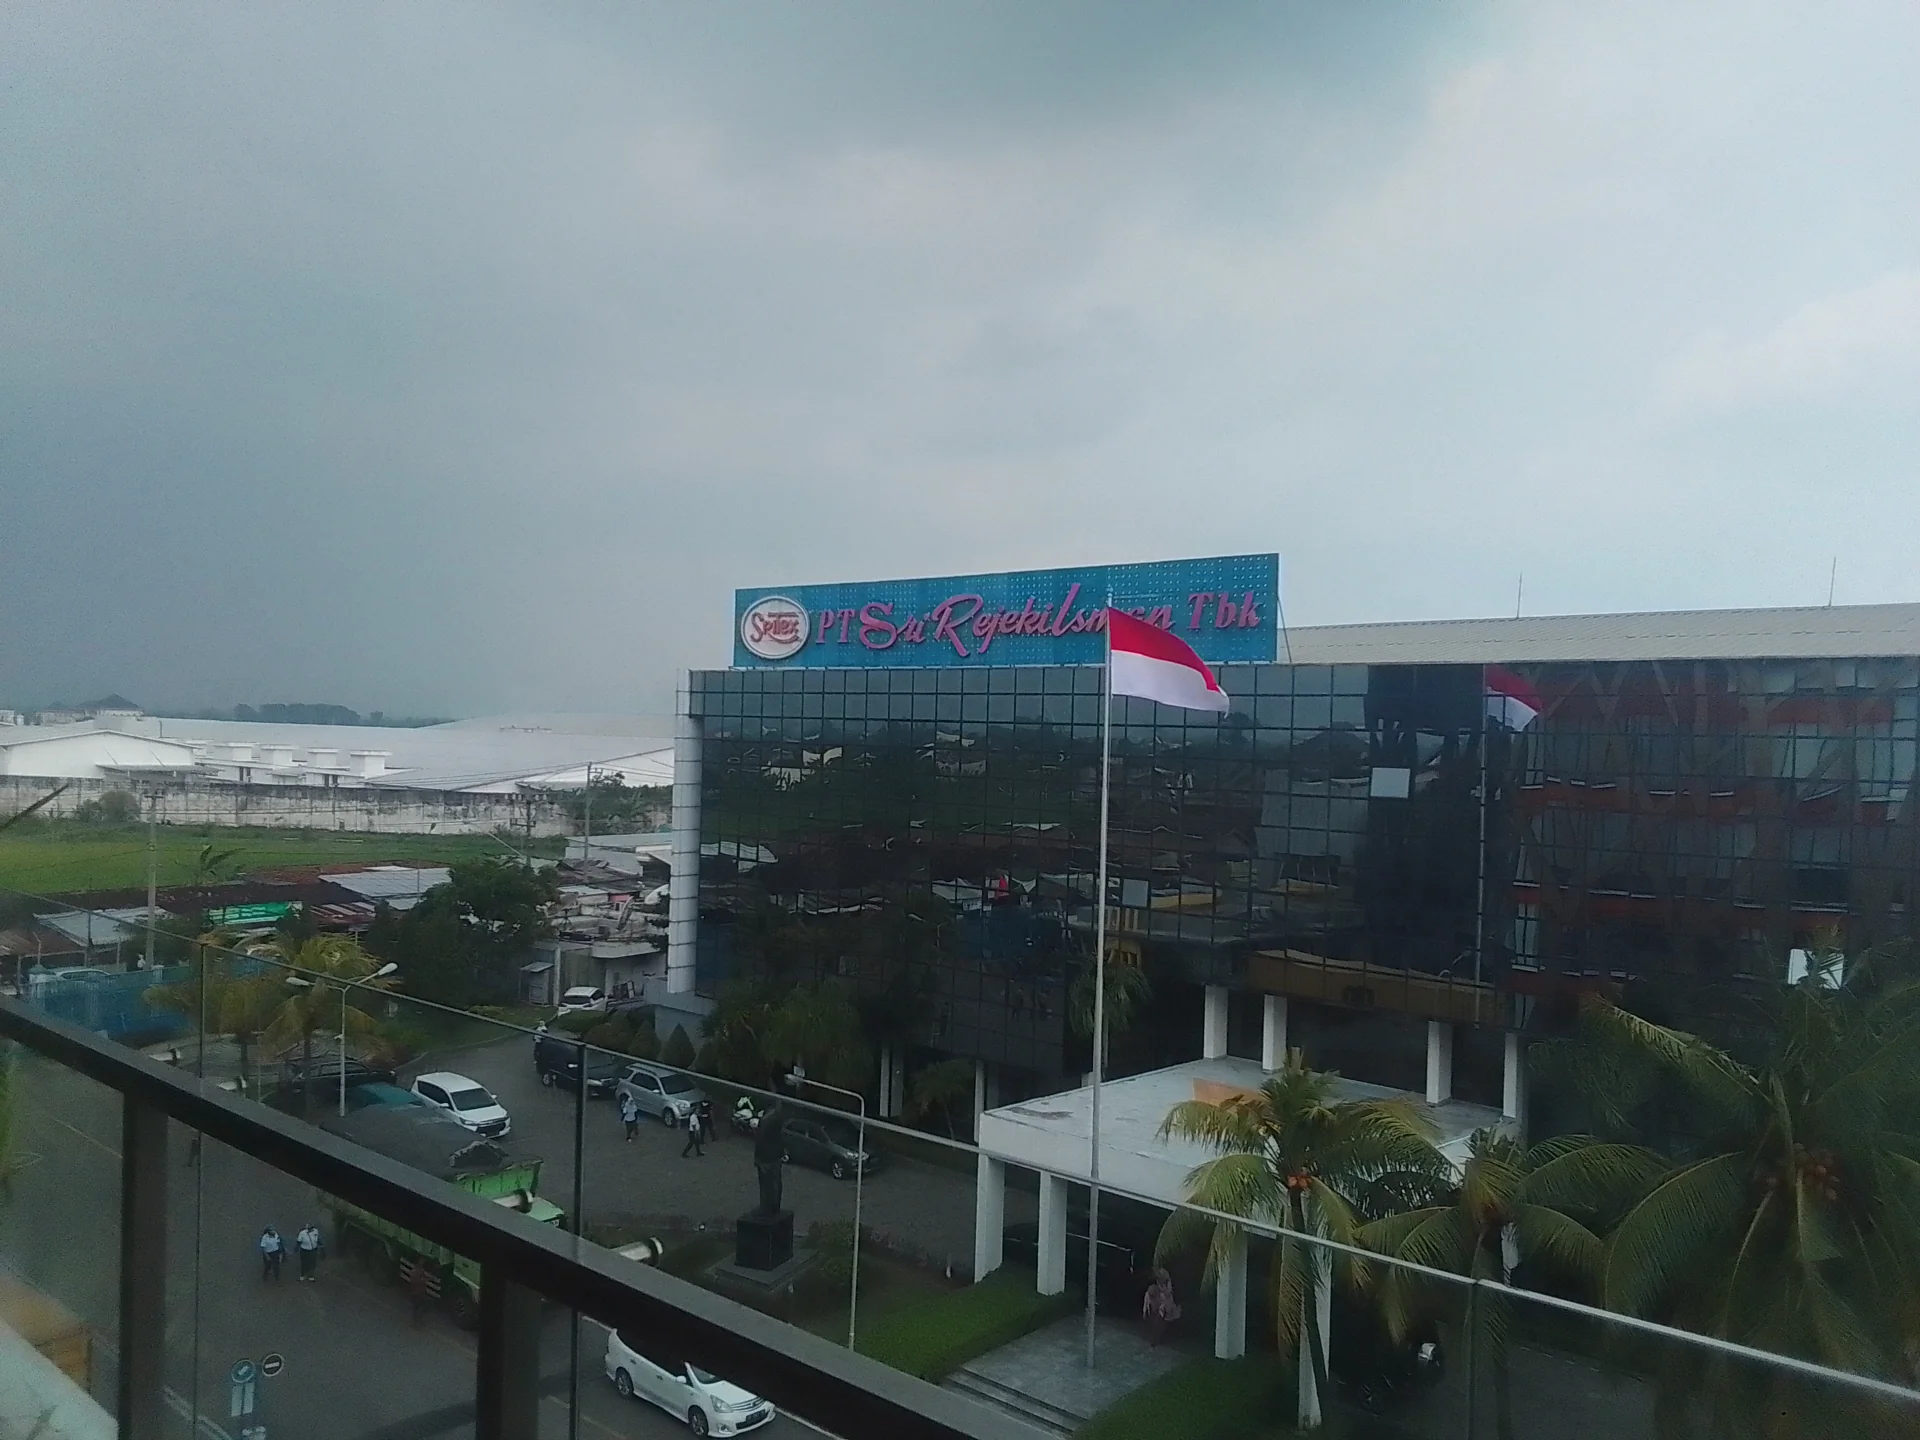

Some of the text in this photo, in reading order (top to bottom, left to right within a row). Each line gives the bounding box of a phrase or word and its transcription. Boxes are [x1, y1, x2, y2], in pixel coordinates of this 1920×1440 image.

[816, 609, 856, 644] PT
[859, 602, 931, 649] Sri
[1187, 591, 1260, 630] Tbk
